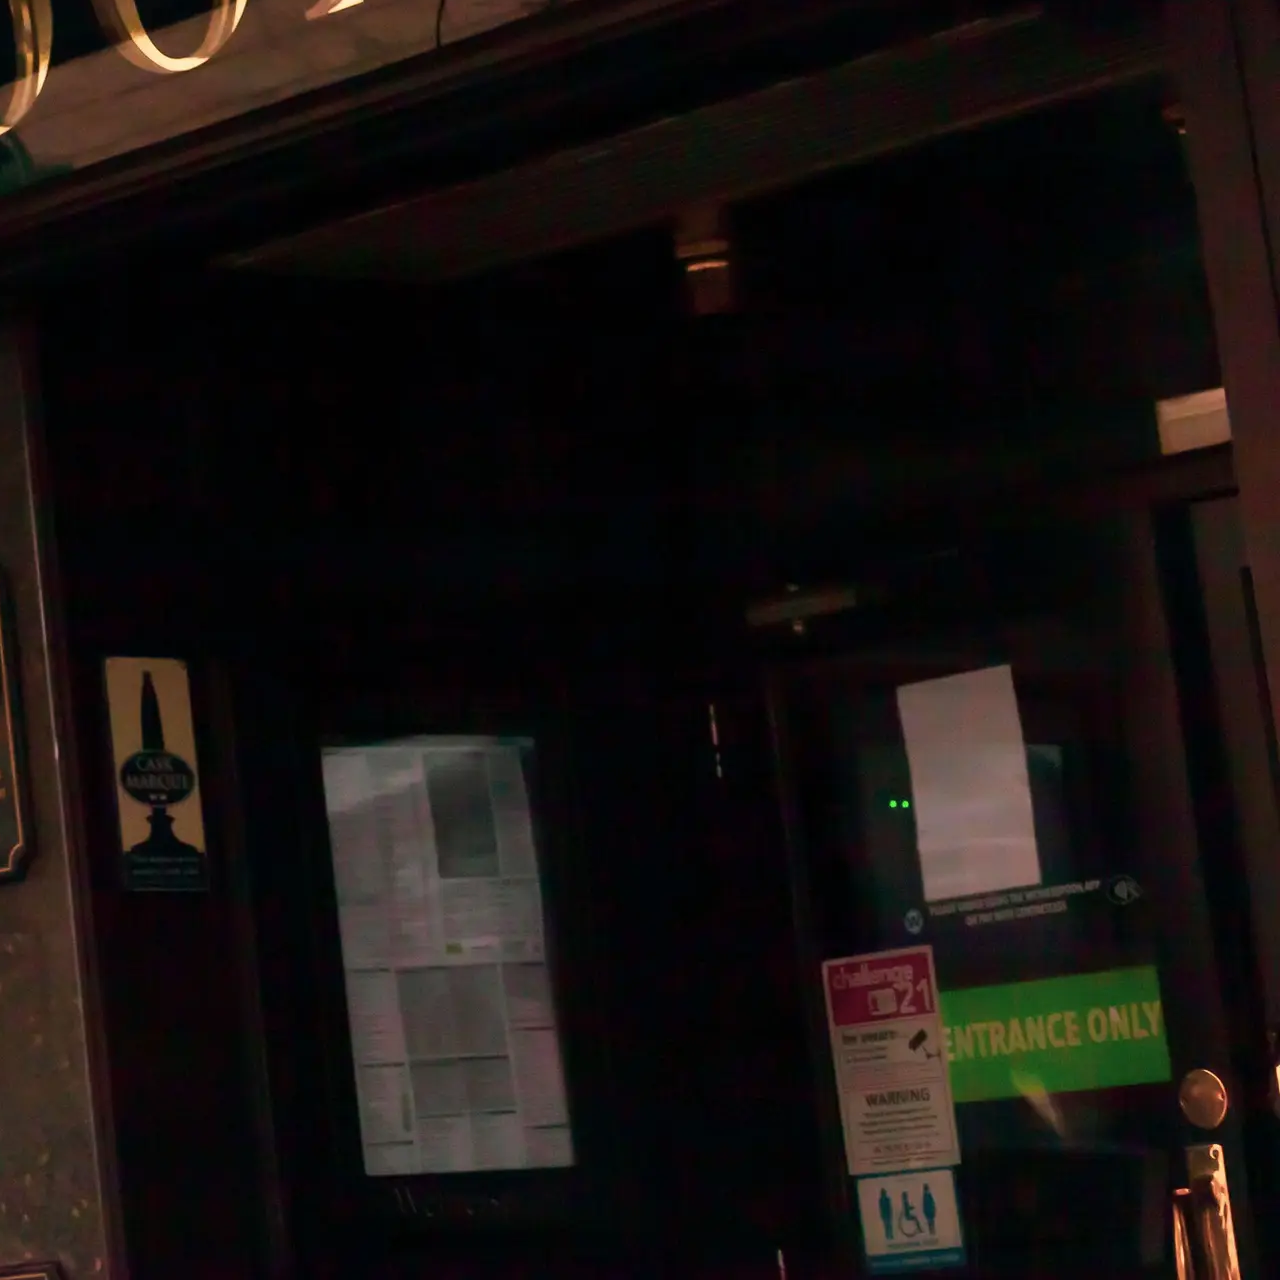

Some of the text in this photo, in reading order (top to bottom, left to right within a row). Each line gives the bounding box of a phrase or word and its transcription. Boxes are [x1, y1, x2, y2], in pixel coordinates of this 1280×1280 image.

[135, 756, 174, 772] CASK
[892, 978, 934, 1014] 21
[942, 999, 1163, 1061] ENTRANCE ONLY
[864, 1087, 931, 1108] WARNING
